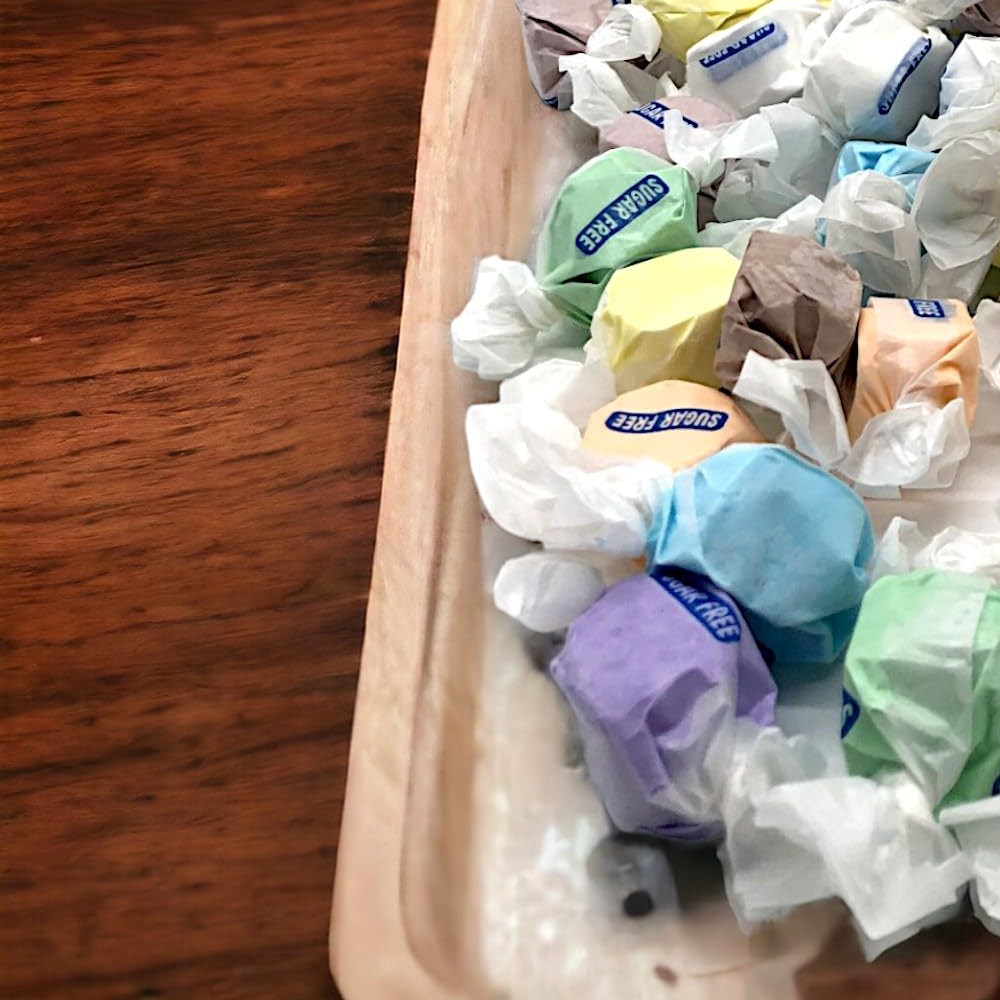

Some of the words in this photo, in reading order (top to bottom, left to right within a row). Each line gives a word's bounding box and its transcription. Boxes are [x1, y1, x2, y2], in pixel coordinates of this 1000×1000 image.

[610, 178, 665, 221] SUGAR
[579, 212, 619, 252] FREE
[611, 413, 659, 431] FREE
[659, 410, 723, 429] SUGAR
[694, 600, 740, 639] FREE
